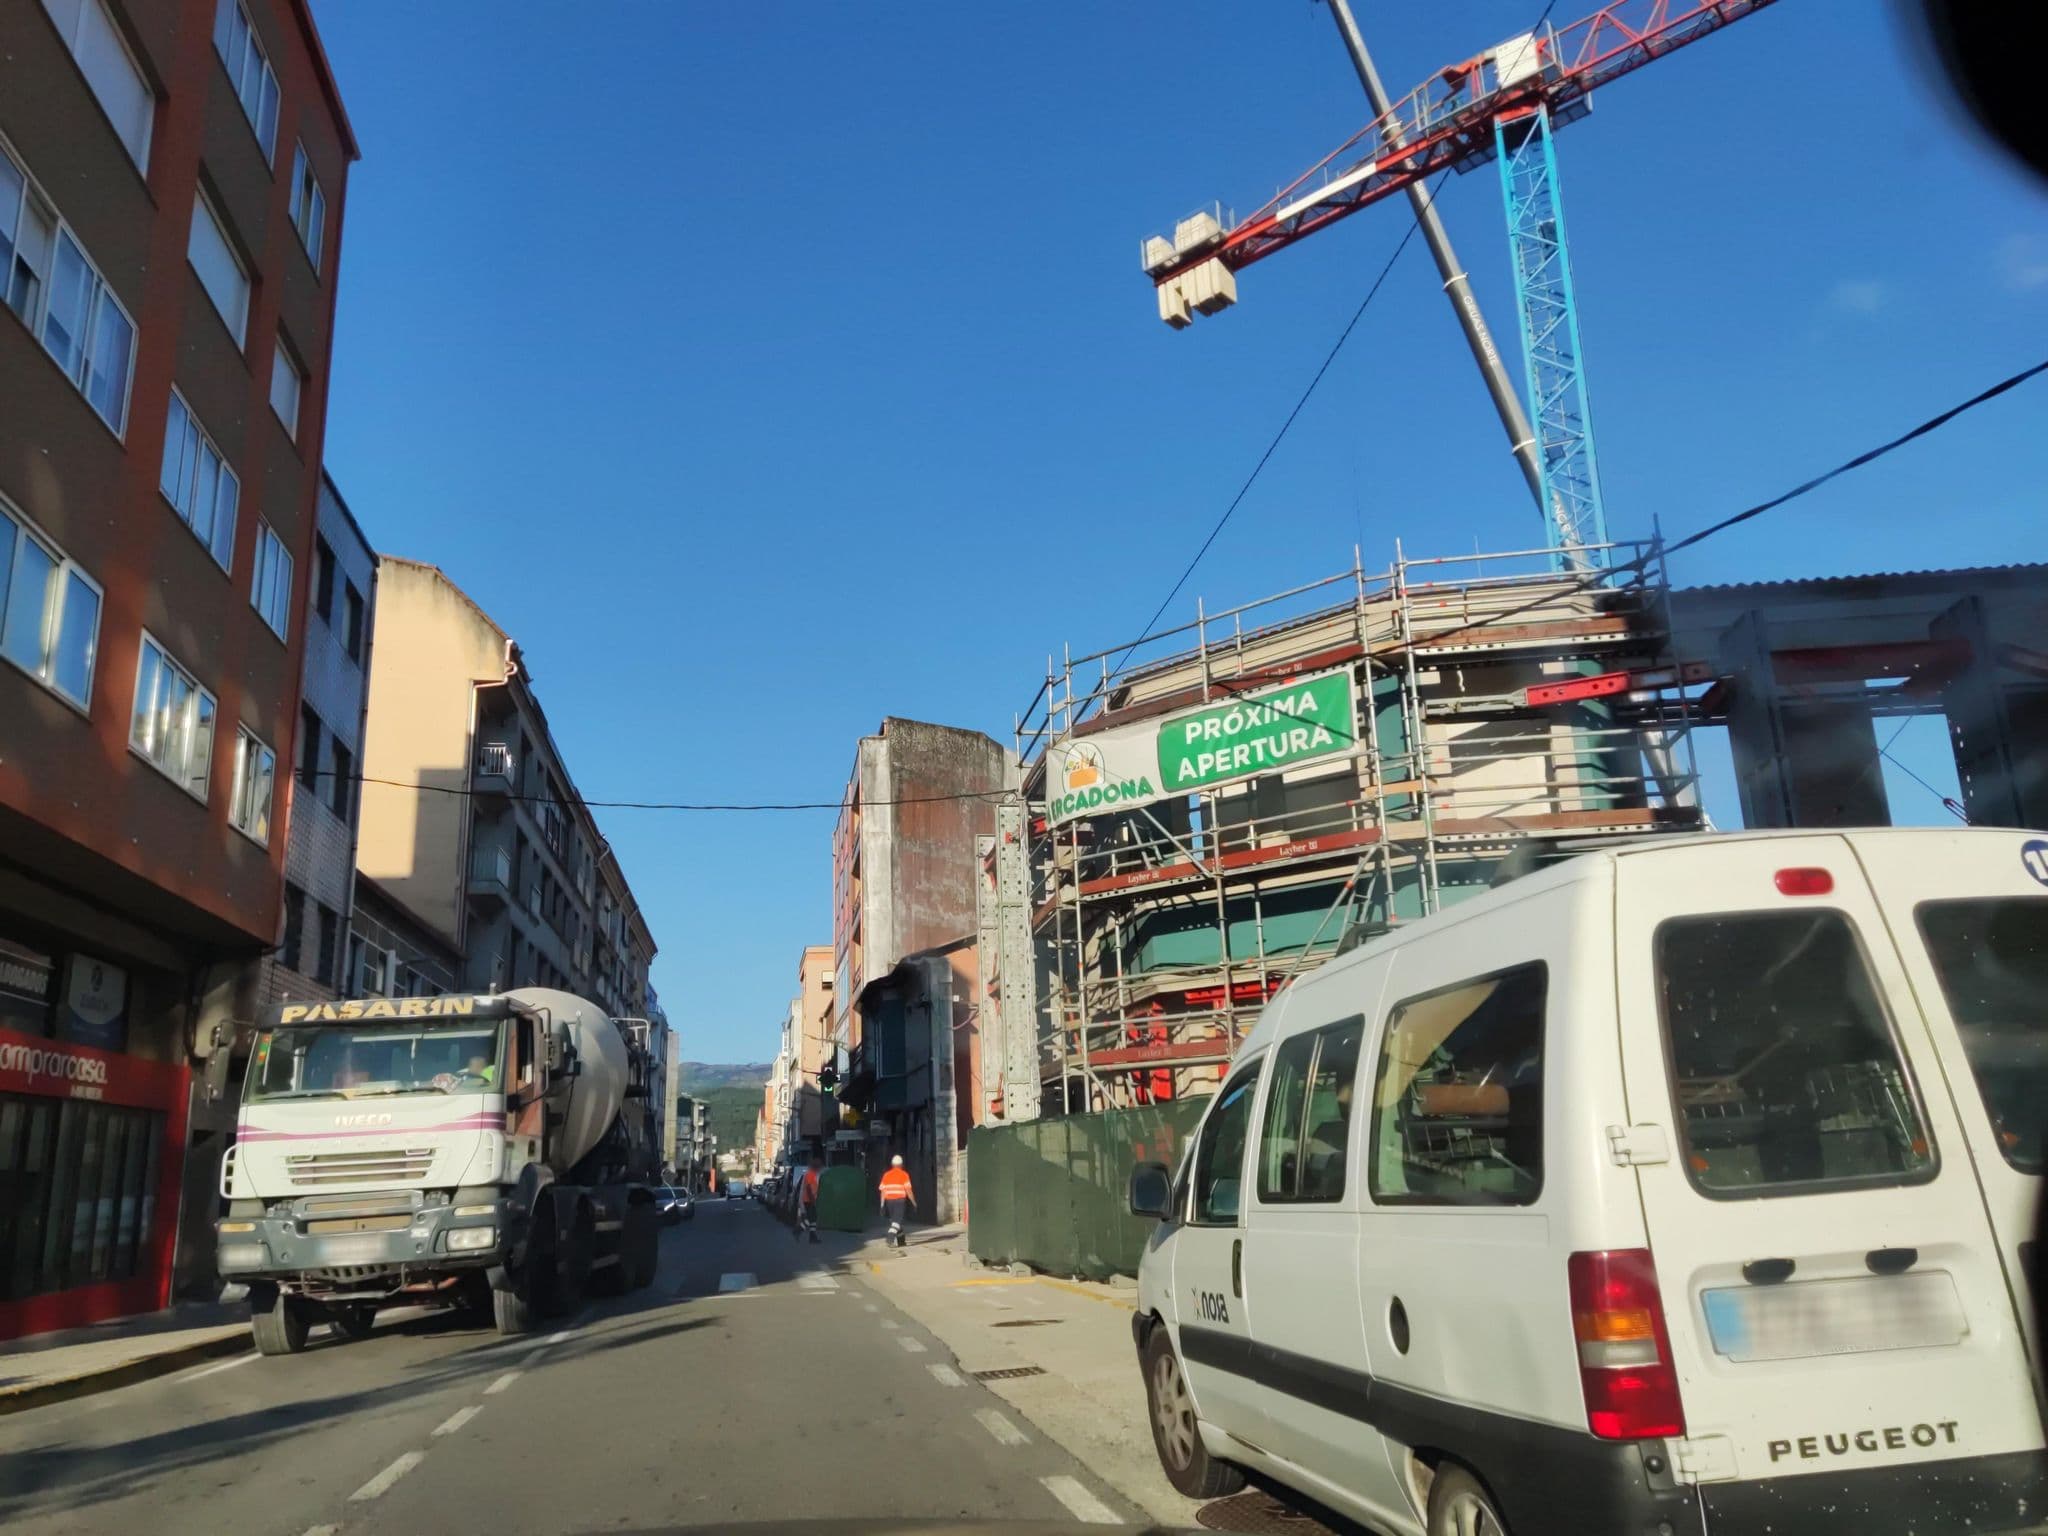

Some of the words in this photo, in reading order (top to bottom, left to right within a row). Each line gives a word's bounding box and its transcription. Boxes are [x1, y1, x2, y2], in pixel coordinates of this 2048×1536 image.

[1186, 690, 1318, 745] PRÓXIMA
[1178, 722, 1333, 782] APERTURA
[280, 996, 474, 1024] PASARIN
[0, 1043, 107, 1085] omprarcasa
[335, 1113, 392, 1127] IVECO
[1768, 1421, 1959, 1463] PEUGEOT
